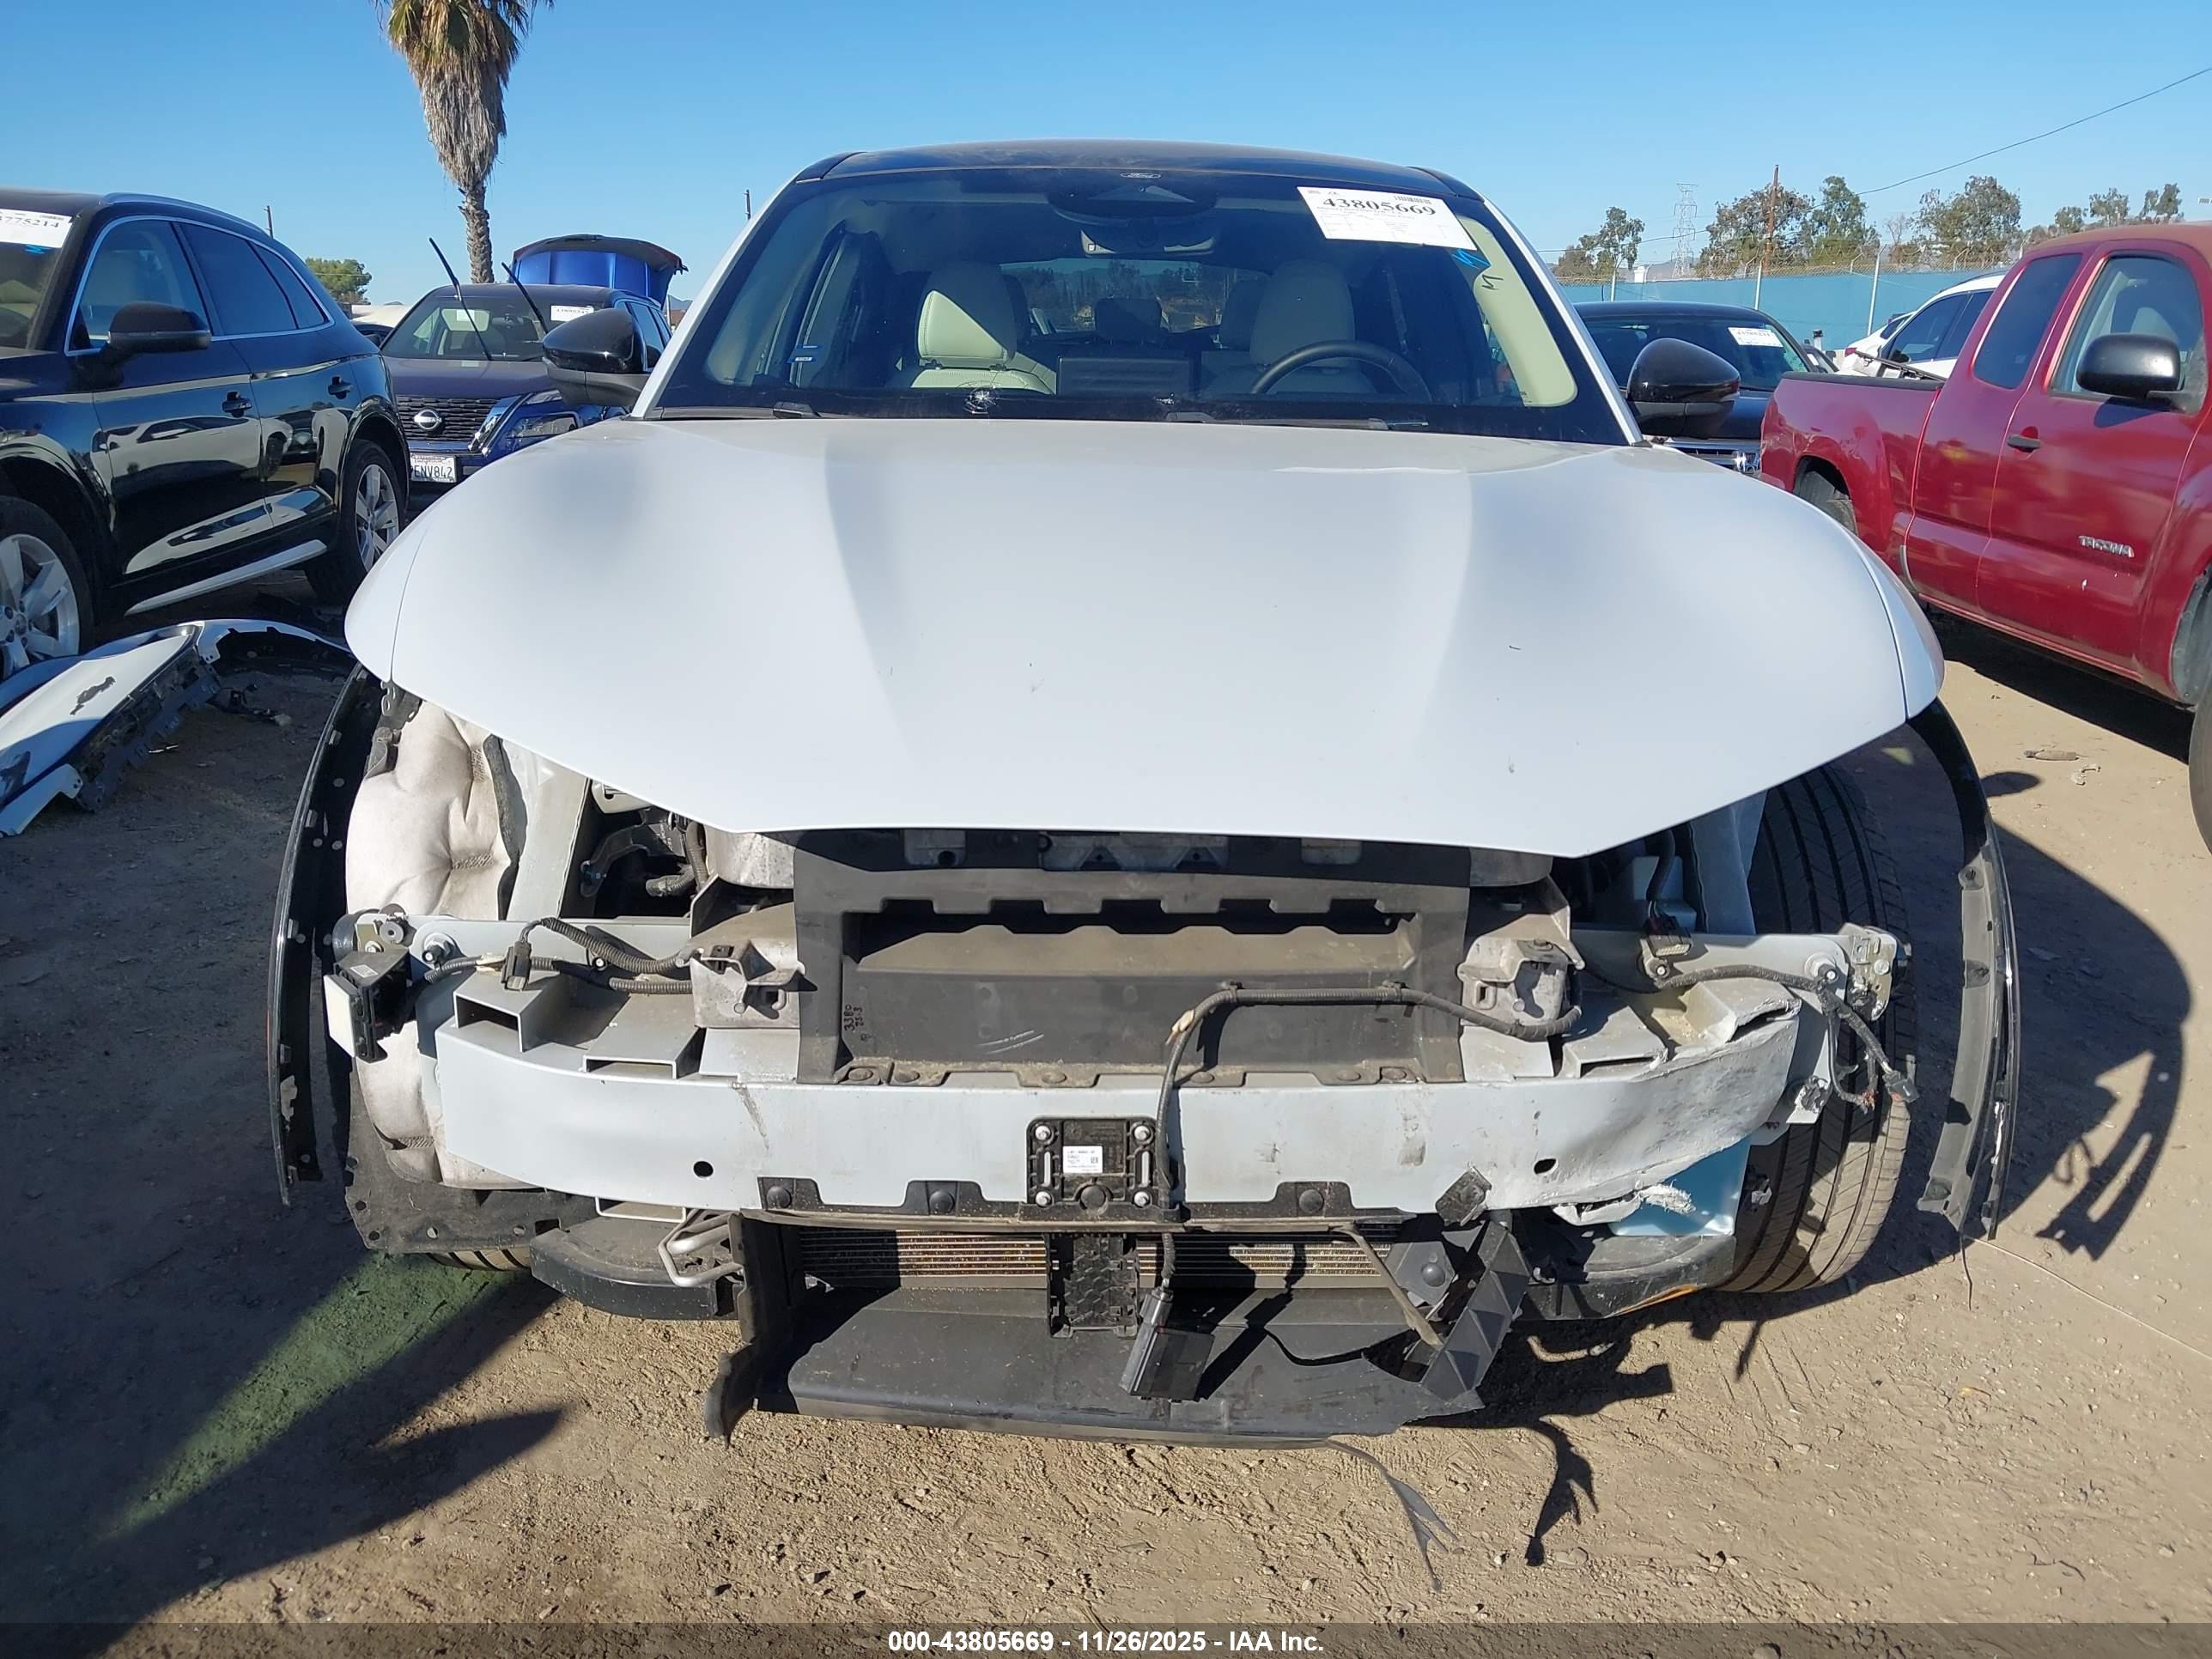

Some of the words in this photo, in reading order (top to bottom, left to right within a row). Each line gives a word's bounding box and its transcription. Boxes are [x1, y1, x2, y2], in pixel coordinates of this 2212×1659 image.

[1322, 198, 1437, 216] 43805669
[0, 216, 59, 228] 775214
[411, 465, 453, 478] ENV842
